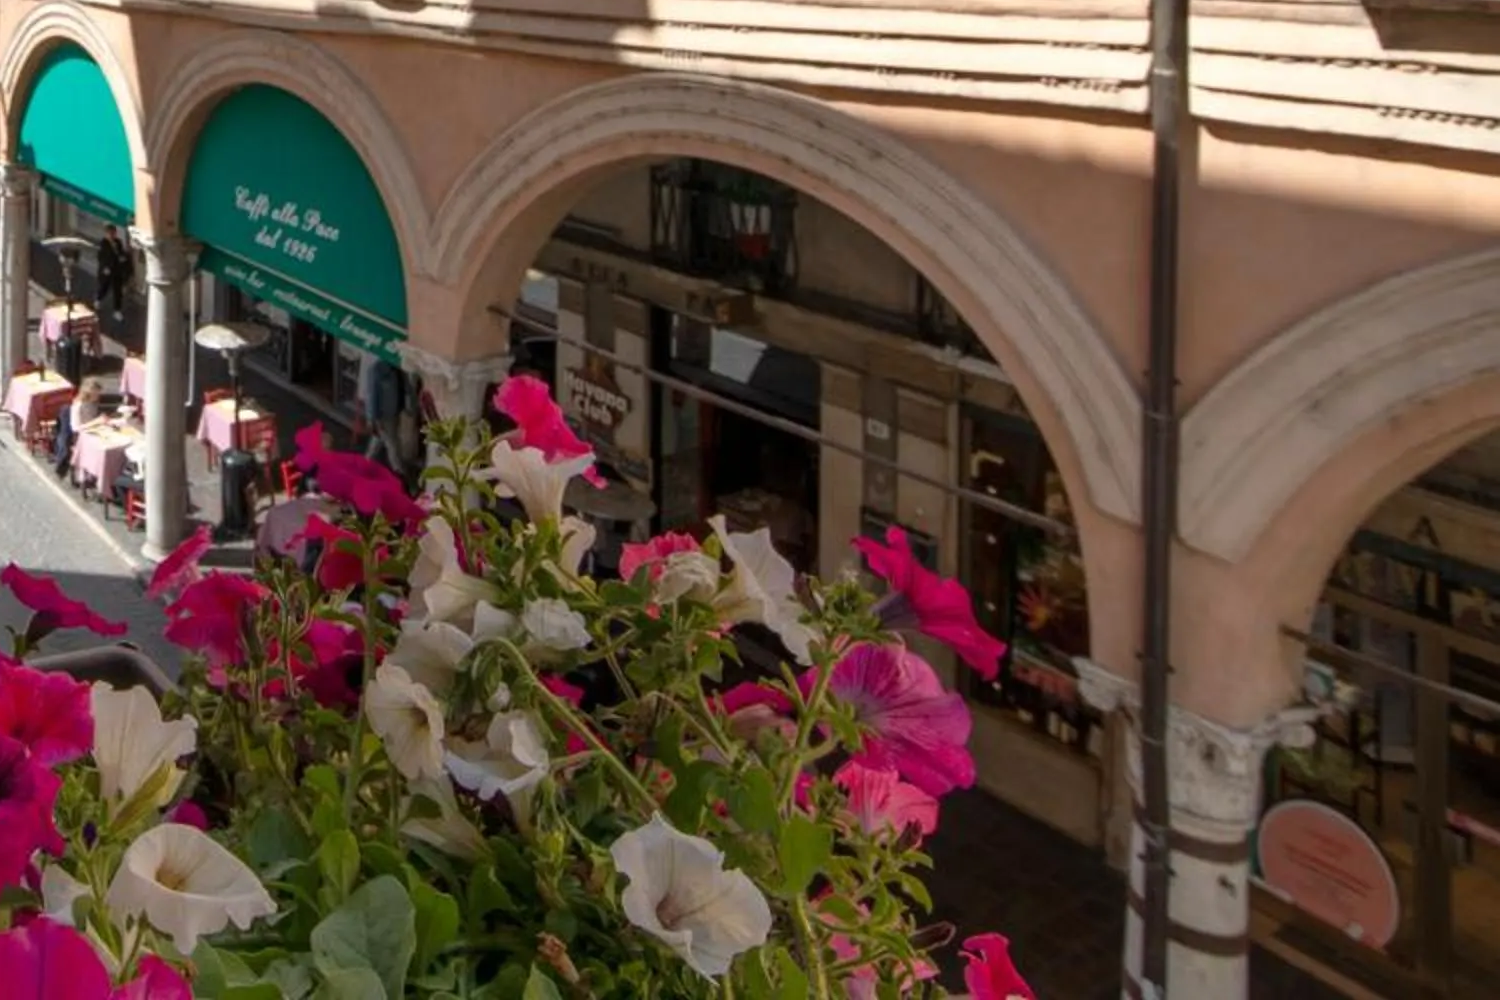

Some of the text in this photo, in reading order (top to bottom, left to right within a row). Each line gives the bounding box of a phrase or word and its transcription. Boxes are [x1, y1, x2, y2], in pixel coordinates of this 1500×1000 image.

[254, 225, 283, 249] dal
[563, 369, 628, 412] Havana
[573, 392, 613, 425] Club
